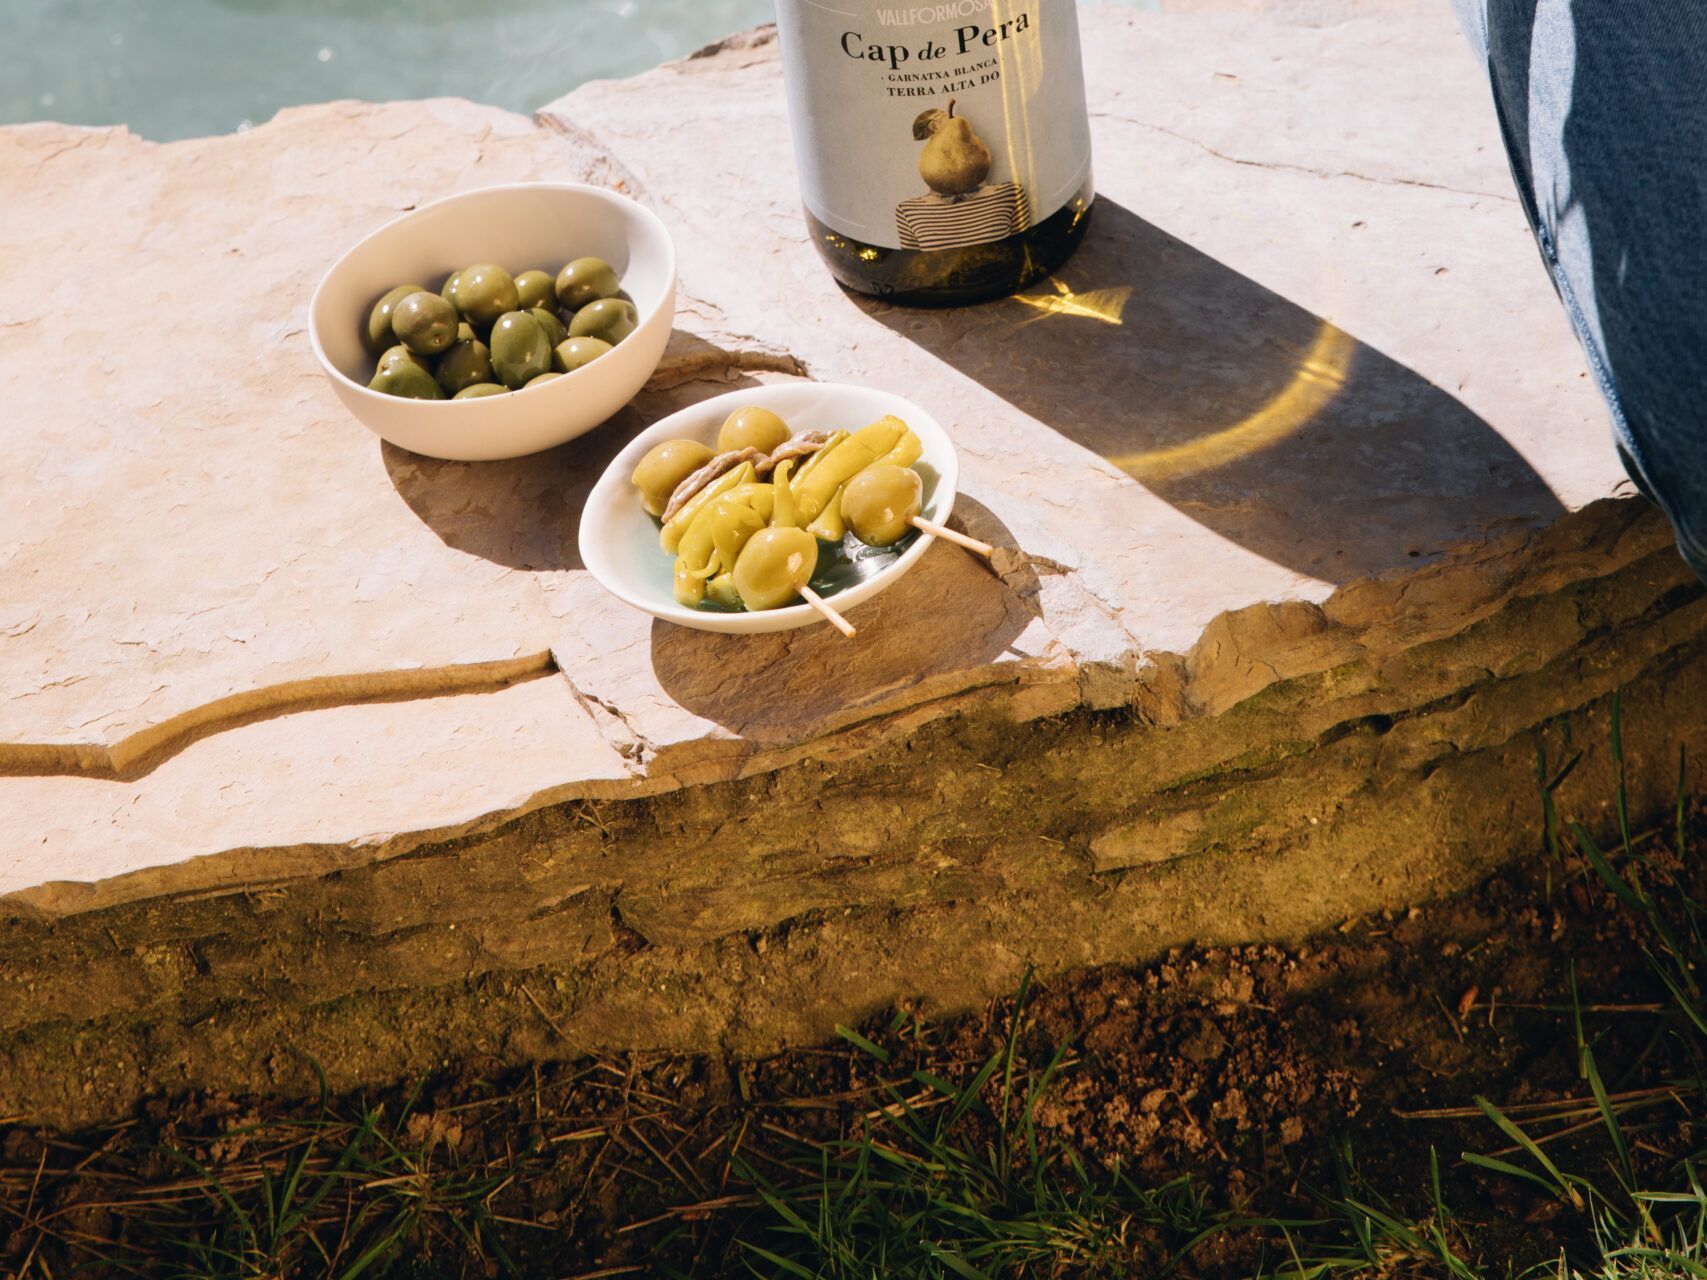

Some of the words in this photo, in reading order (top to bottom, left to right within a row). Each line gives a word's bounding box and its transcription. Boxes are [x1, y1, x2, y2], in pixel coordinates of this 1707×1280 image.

[840, 31, 910, 71] Cap
[917, 41, 946, 61] de
[953, 12, 1030, 55] Pera
[886, 86, 936, 97] TERRA
[941, 79, 976, 94] ALTA
[980, 70, 1000, 85] DO
[888, 70, 950, 83] GARNATXA
[954, 57, 998, 77] BLANCA
